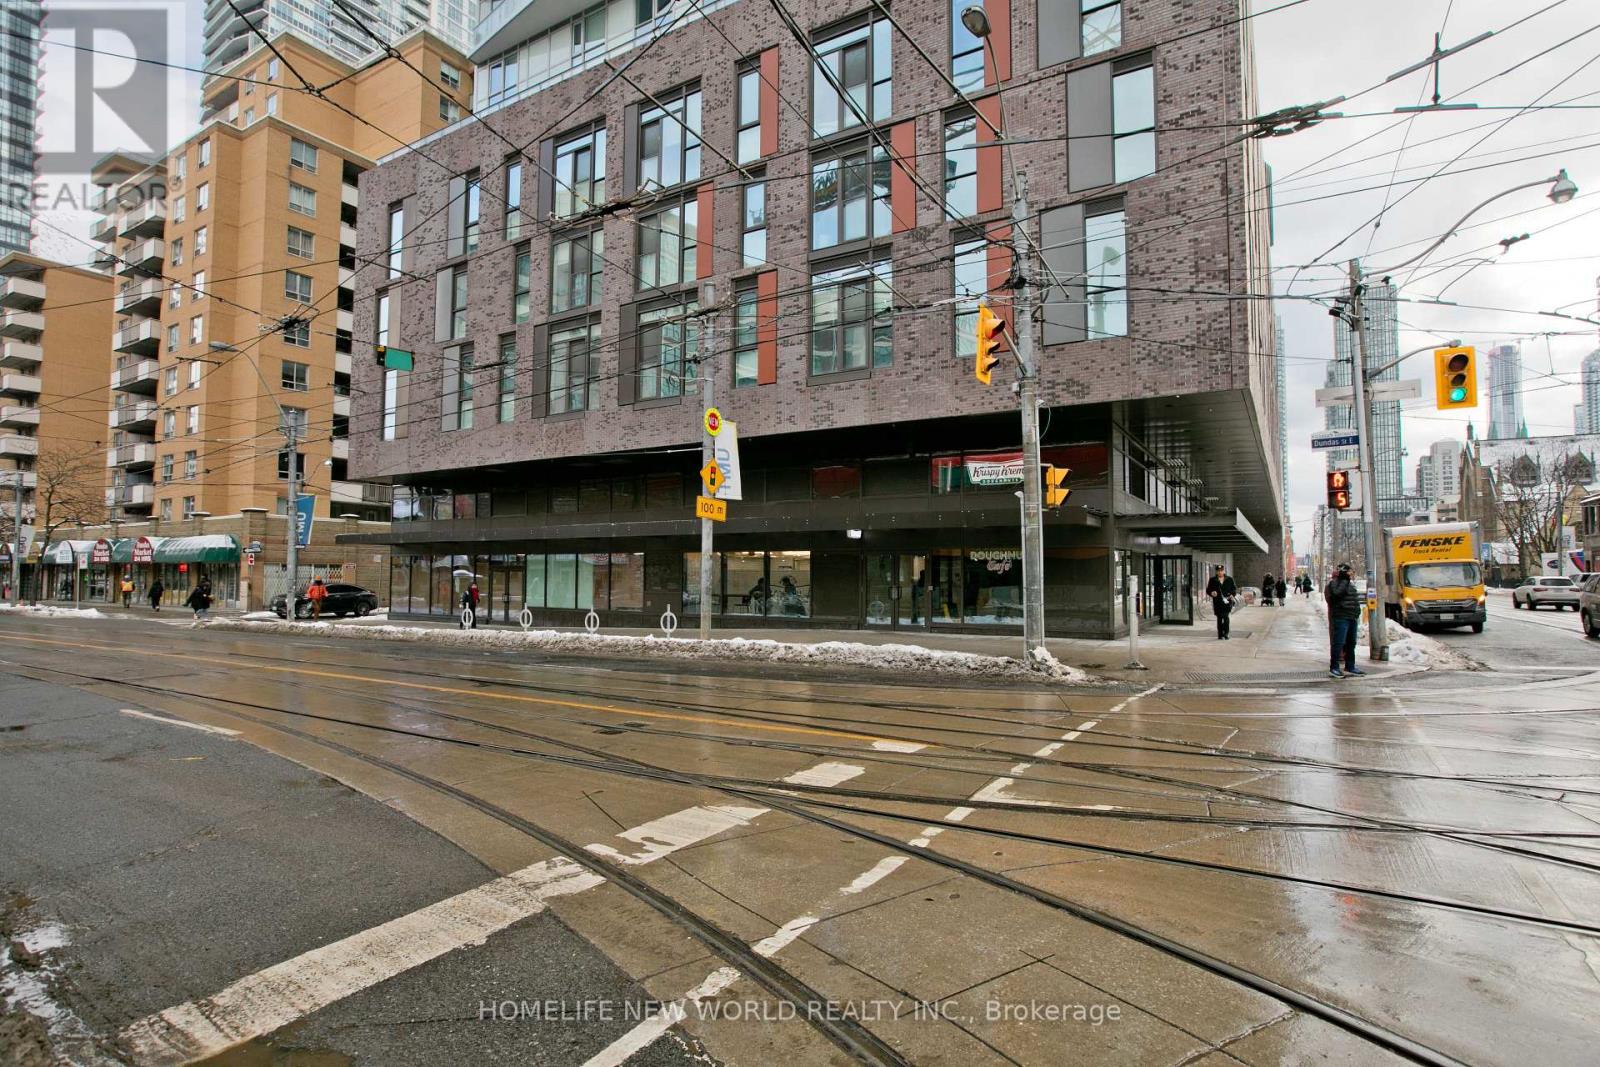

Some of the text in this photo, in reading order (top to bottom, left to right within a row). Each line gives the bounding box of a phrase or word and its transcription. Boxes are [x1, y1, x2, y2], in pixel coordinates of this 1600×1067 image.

[1314, 437, 1339, 447] Dundas
[973, 465, 1001, 478] Krispy
[701, 501, 715, 514] 100
[1399, 535, 1465, 549] PENSKE
[969, 550, 1023, 560] DOUGHNU
[1430, 546, 1452, 554] Rental
